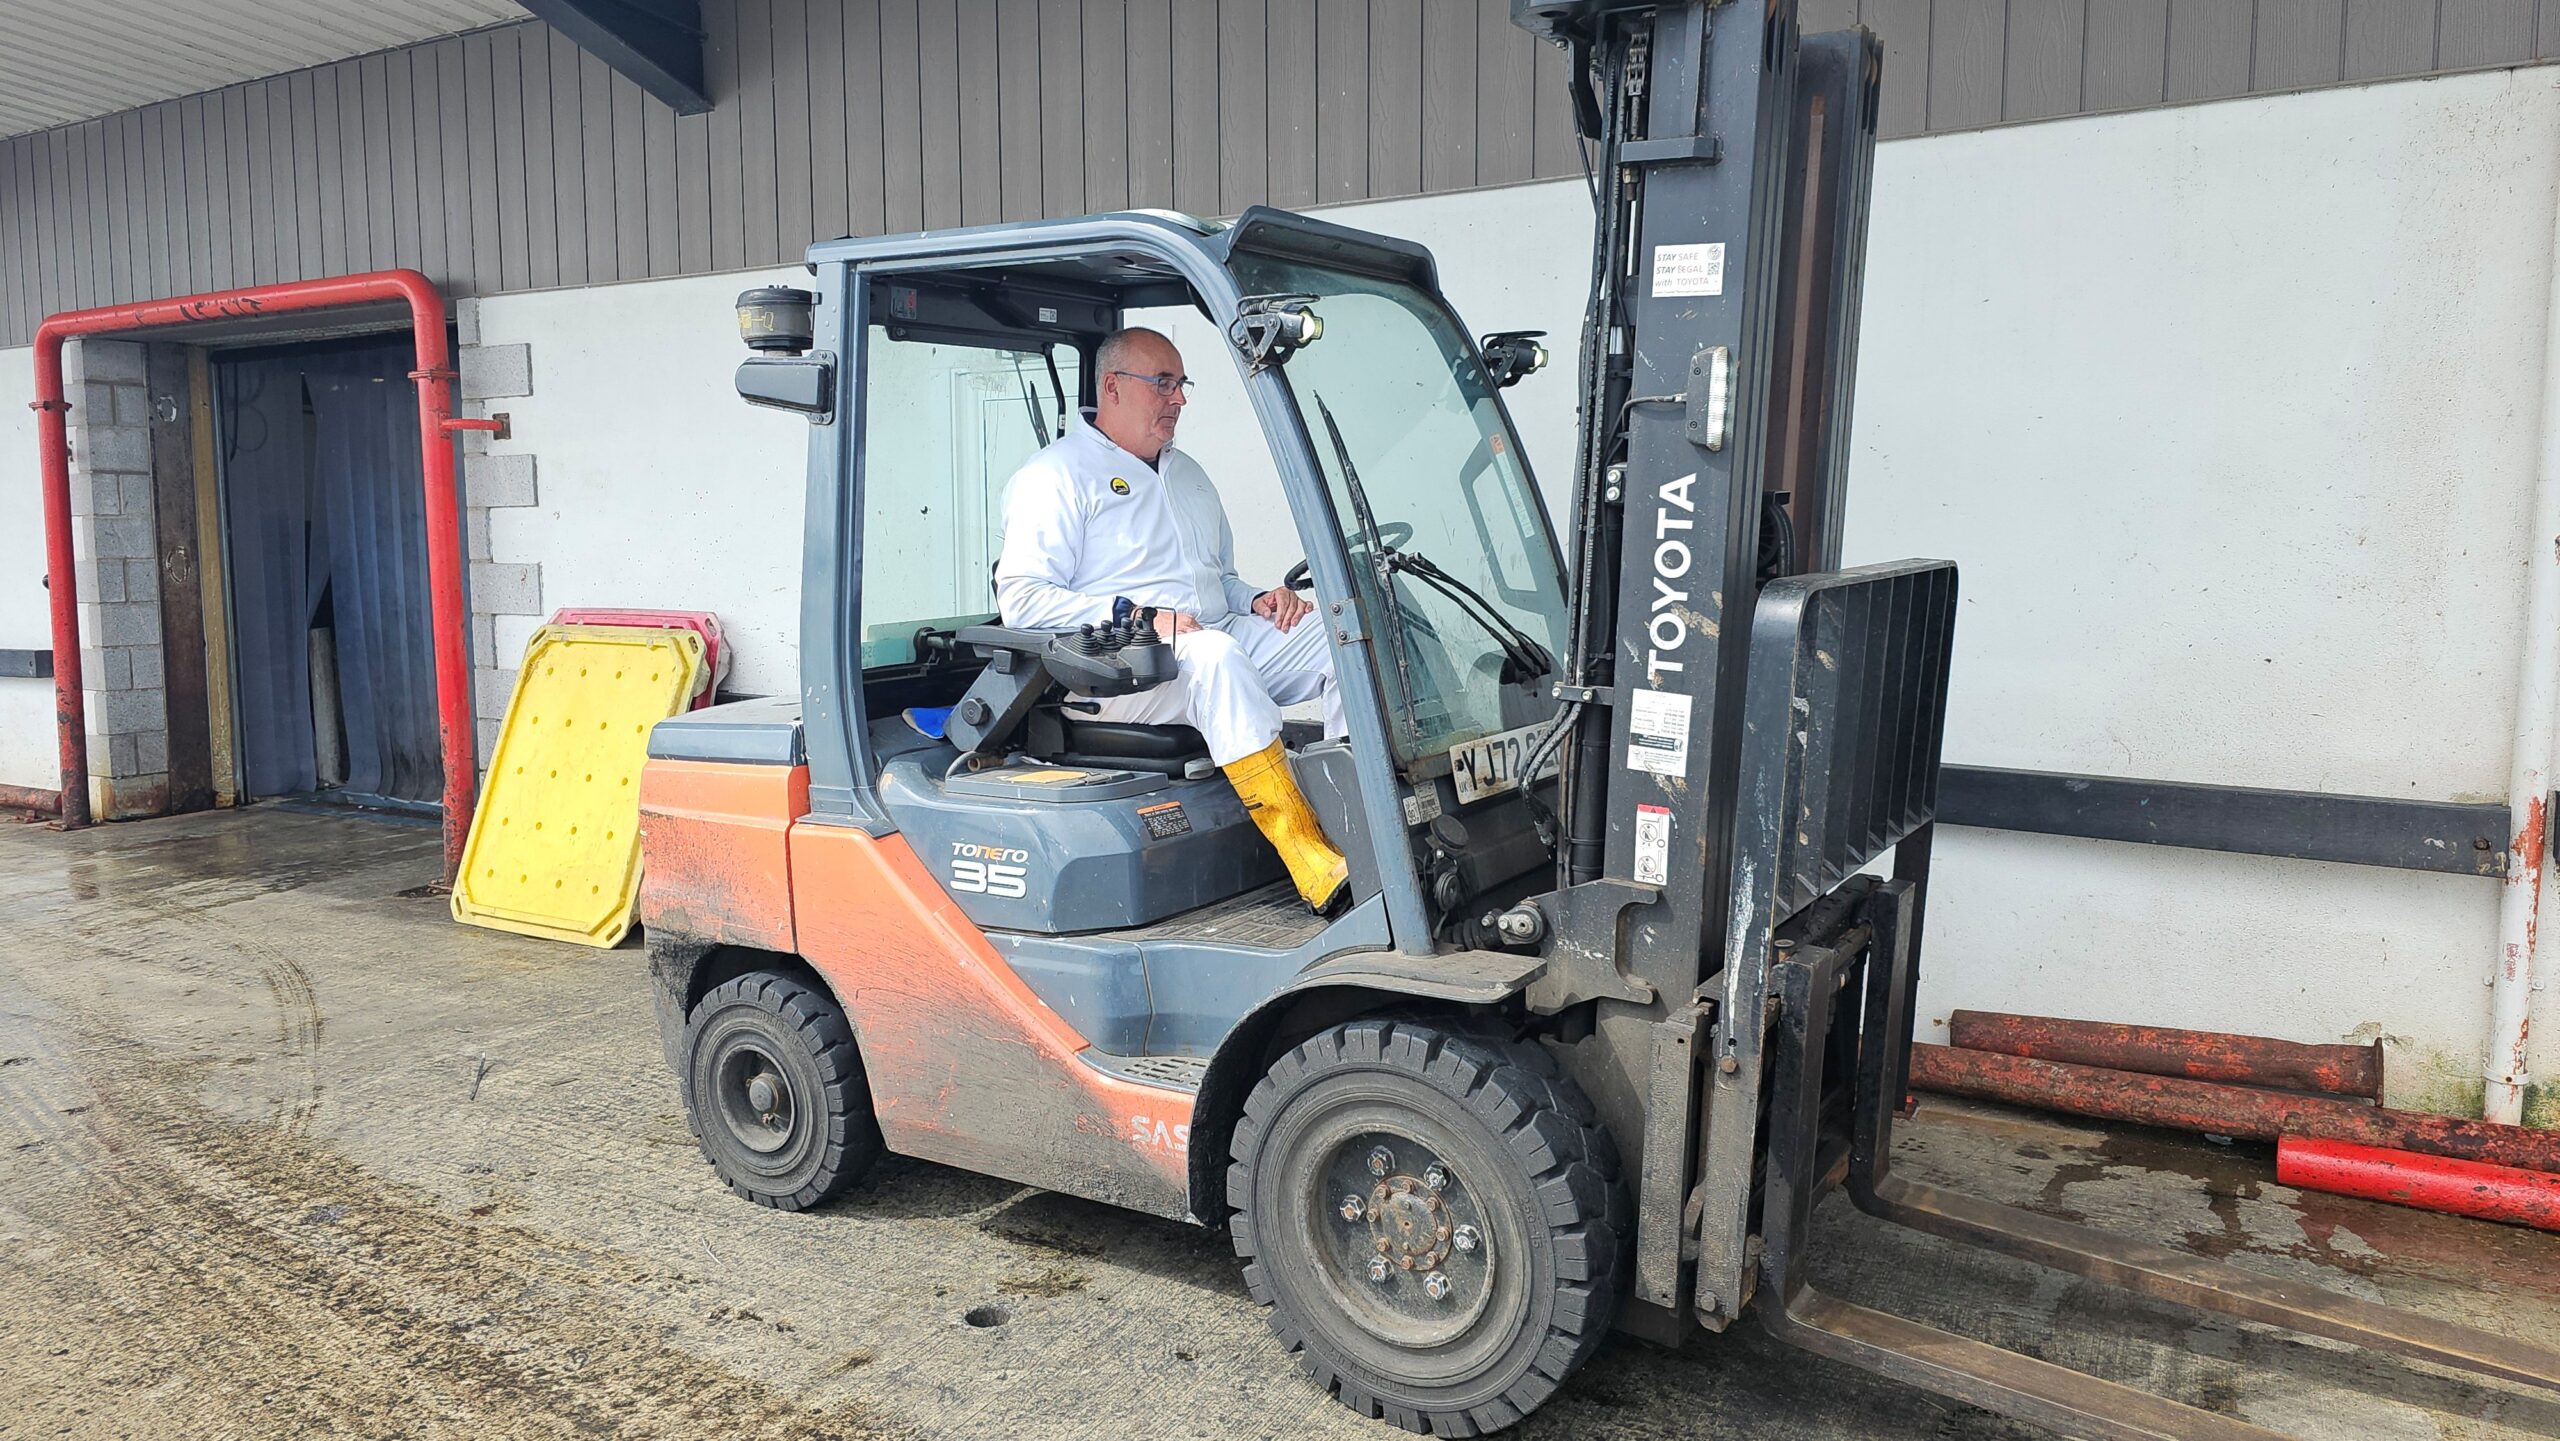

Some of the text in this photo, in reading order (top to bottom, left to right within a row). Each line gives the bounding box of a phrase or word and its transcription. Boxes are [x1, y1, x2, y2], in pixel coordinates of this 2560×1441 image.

[1657, 252, 1699, 262] STAY SAFE
[1656, 266, 1676, 275] STAY
[1655, 277, 1709, 287] with TOYOTA
[1647, 472, 1697, 680] TOYOTA
[950, 859, 1027, 899] 35
